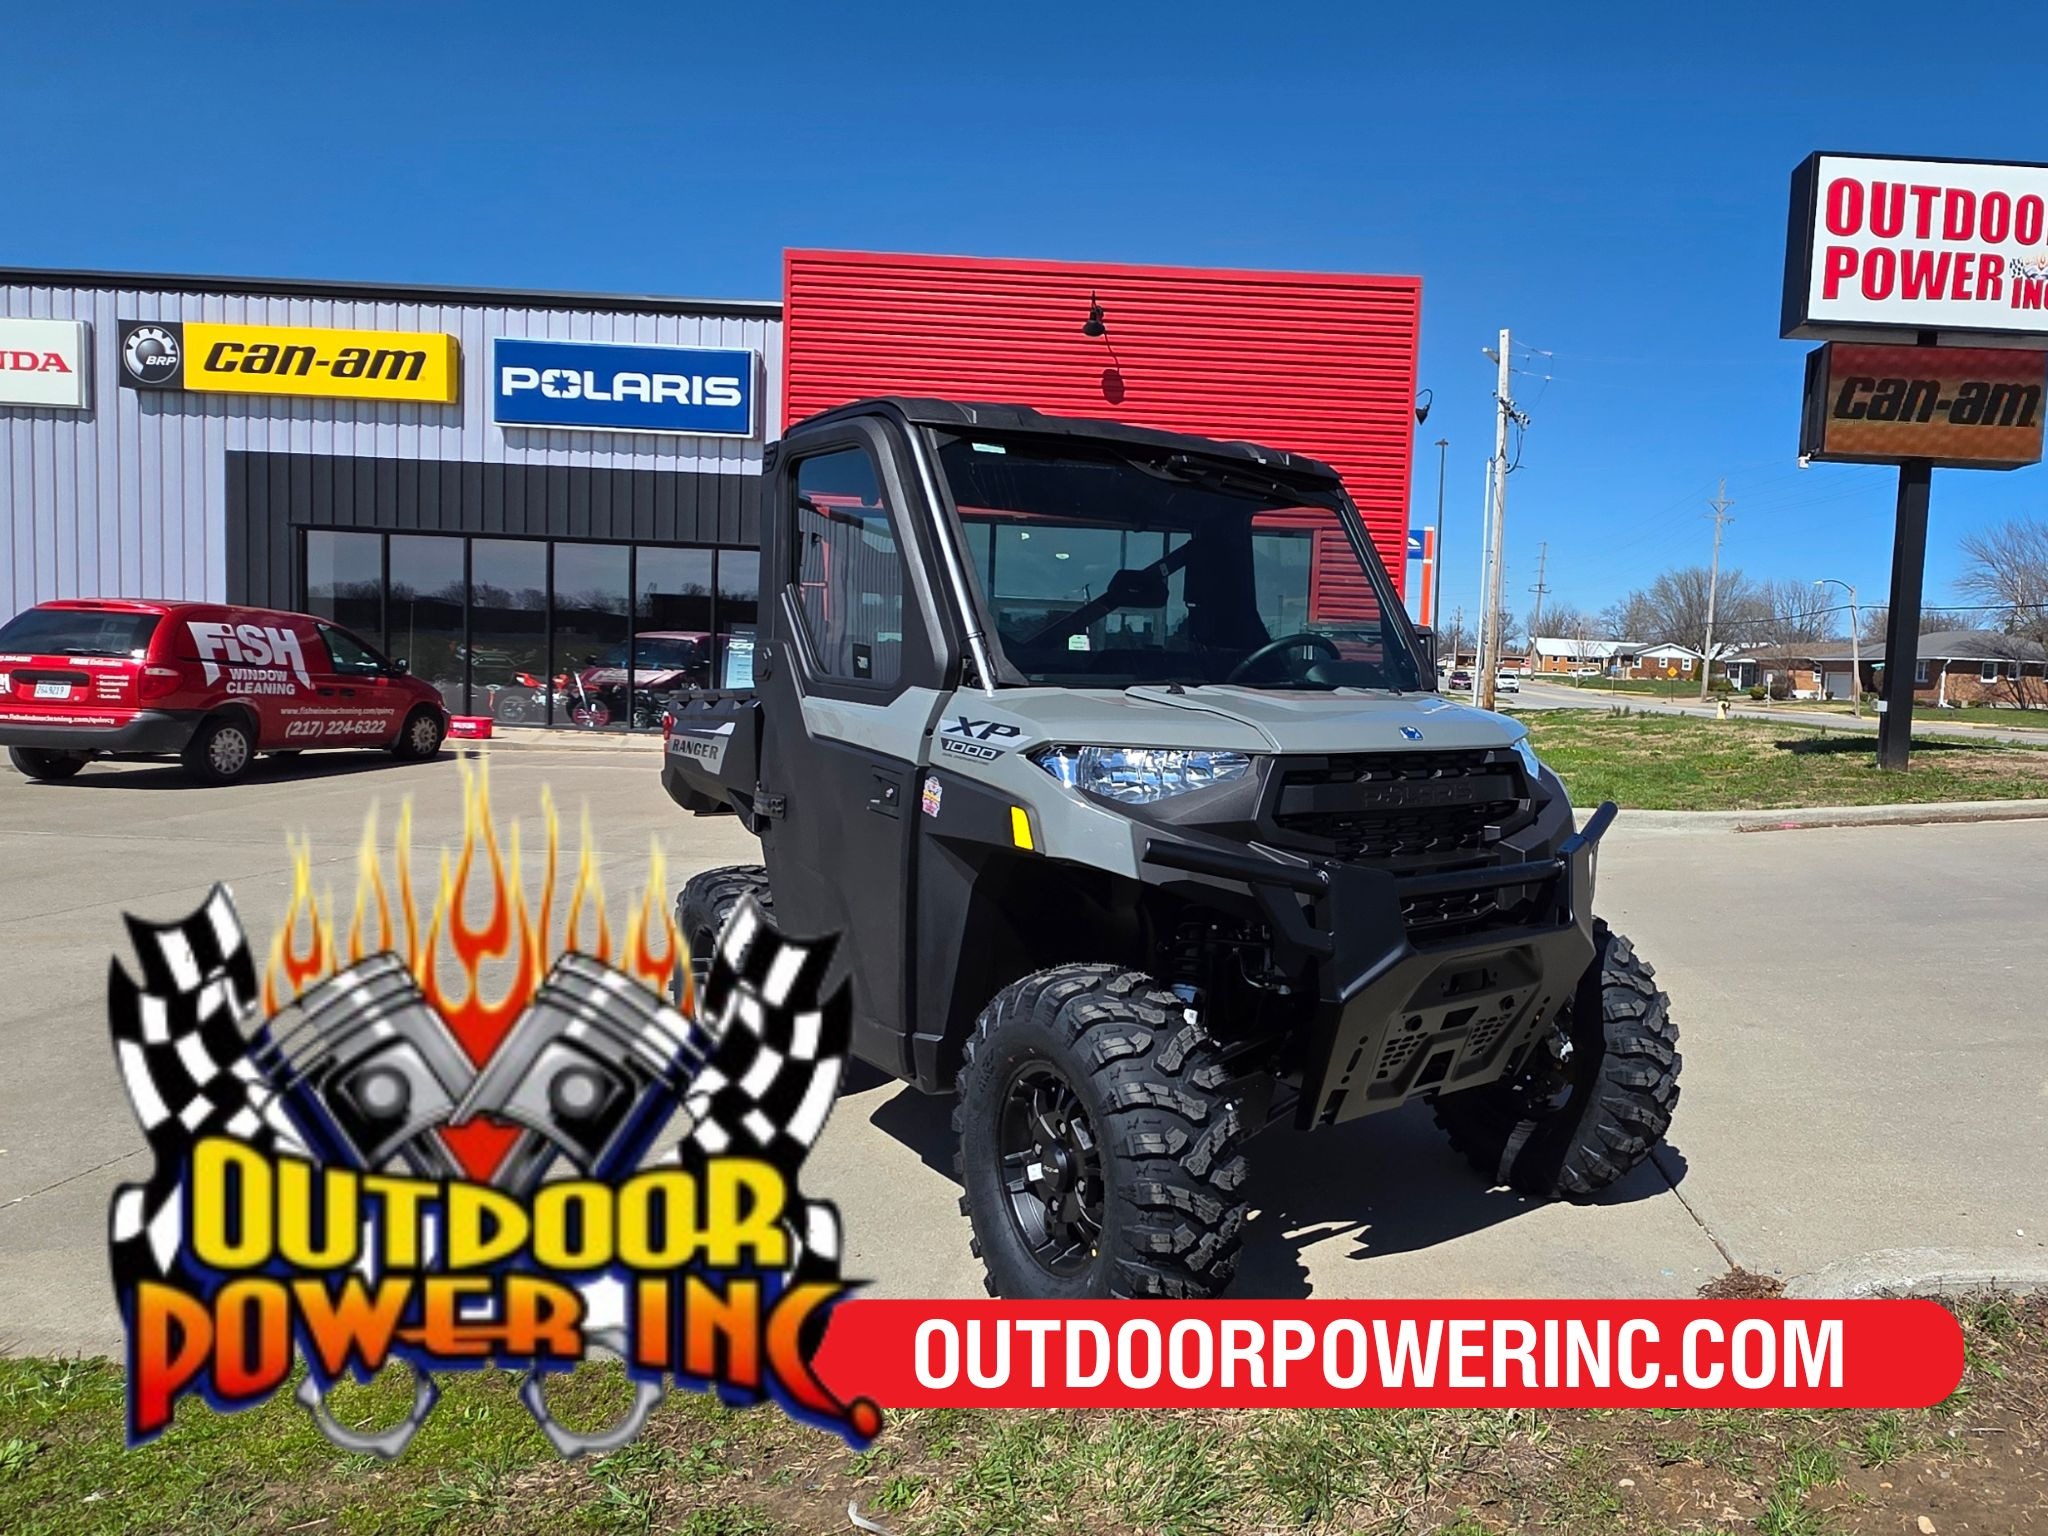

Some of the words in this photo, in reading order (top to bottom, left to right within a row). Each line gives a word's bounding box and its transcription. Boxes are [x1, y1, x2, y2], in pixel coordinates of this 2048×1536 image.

[1825, 177, 2048, 246] OUTDOO
[1822, 246, 2005, 301] POWER
[0, 351, 73, 373] DA
[146, 355, 177, 367] BRP
[502, 366, 742, 407] POLARIS
[229, 668, 287, 682] WINDOW
[226, 682, 295, 695] CLEANING
[285, 720, 325, 738] (217)
[325, 720, 387, 735] 224-6322
[942, 716, 1021, 741] XP
[672, 738, 719, 760] RANGER
[945, 741, 997, 760] 1000
